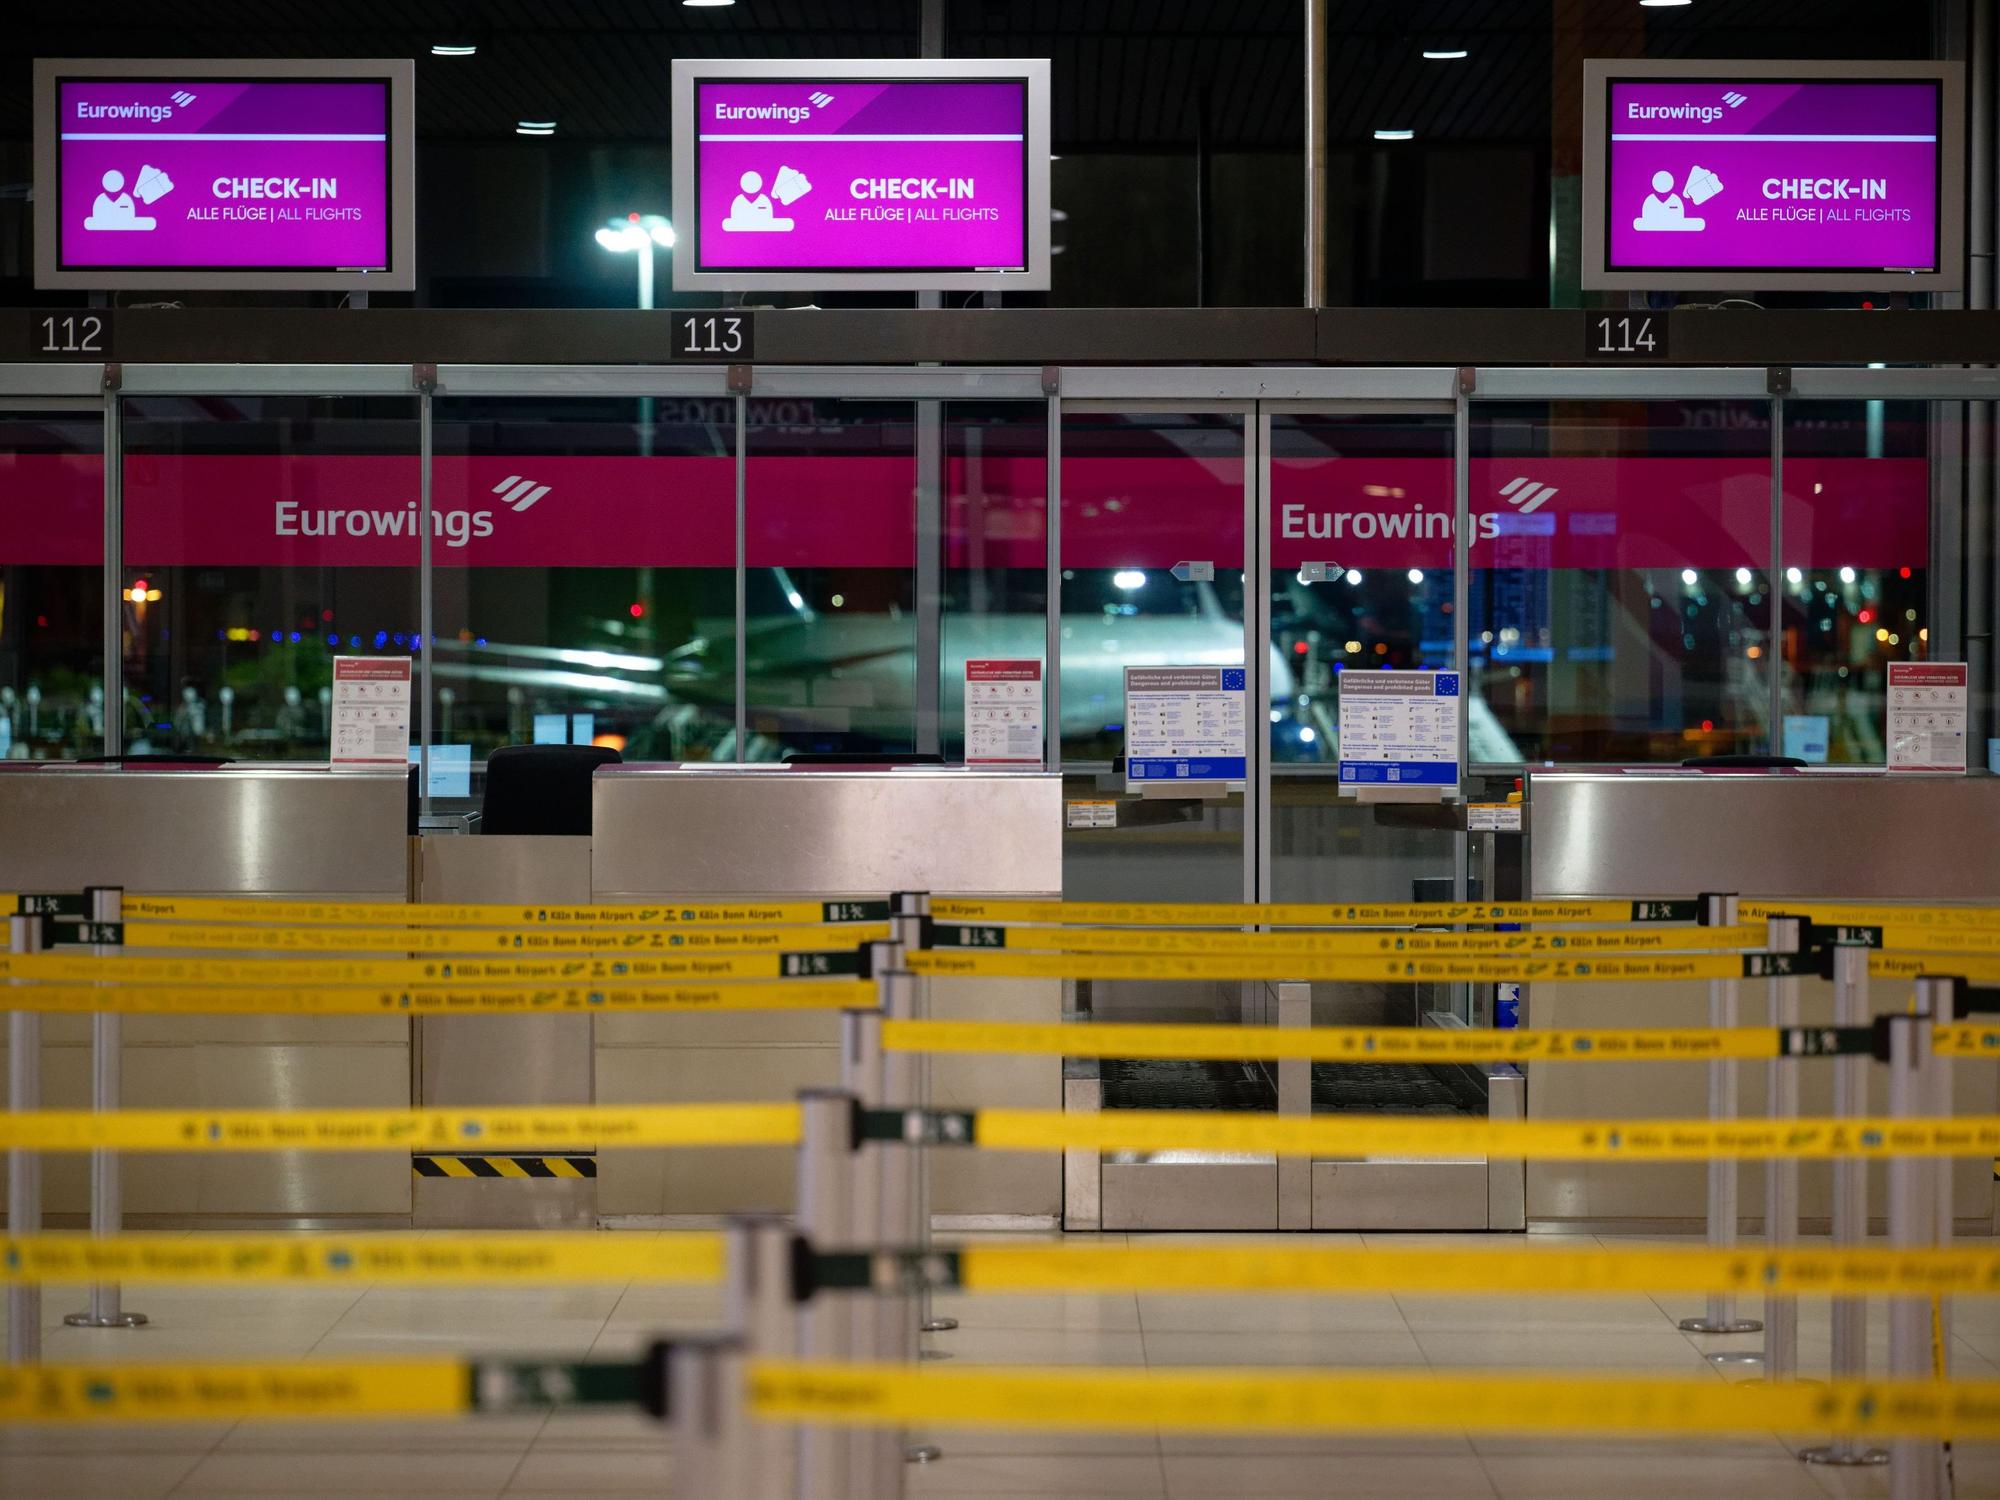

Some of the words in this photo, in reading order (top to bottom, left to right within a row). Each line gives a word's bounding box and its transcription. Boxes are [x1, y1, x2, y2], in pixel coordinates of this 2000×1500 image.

[77, 102, 172, 122] Eurowings
[715, 103, 810, 123] Eurowings
[1627, 103, 1722, 123] Eurowings
[212, 178, 337, 199] CHECK-IN
[850, 179, 975, 200] CHECK-IN
[1761, 179, 1886, 200] CHECK-IN
[187, 207, 219, 222] ALLE
[222, 204, 267, 222] FLÜGE
[277, 207, 301, 222] ALL
[305, 207, 362, 222] FLIGHTS
[825, 208, 857, 223] ALLE
[860, 205, 905, 223] FLÜGE
[915, 208, 939, 223] ALL
[943, 208, 1000, 223] FLIGHTS
[1736, 208, 1768, 223] ALLE
[1771, 205, 1816, 223] FLÜGE
[1826, 208, 1850, 223] ALL
[1854, 208, 1911, 223] FLIGHTS
[42, 317, 102, 351] 112
[684, 318, 742, 352] 113
[1599, 318, 1656, 352] 114
[275, 501, 494, 547] Eurowings
[141, 902, 175, 913] Airport
[575, 910, 596, 919] Bonn
[600, 910, 634, 920] Airport
[723, 910, 744, 918] Bonn
[748, 910, 782, 919] Airport
[1384, 908, 1404, 917] Bonn
[1408, 908, 1443, 918] Airport
[1532, 906, 1553, 915] Bonn
[1557, 906, 1592, 916] Airport
